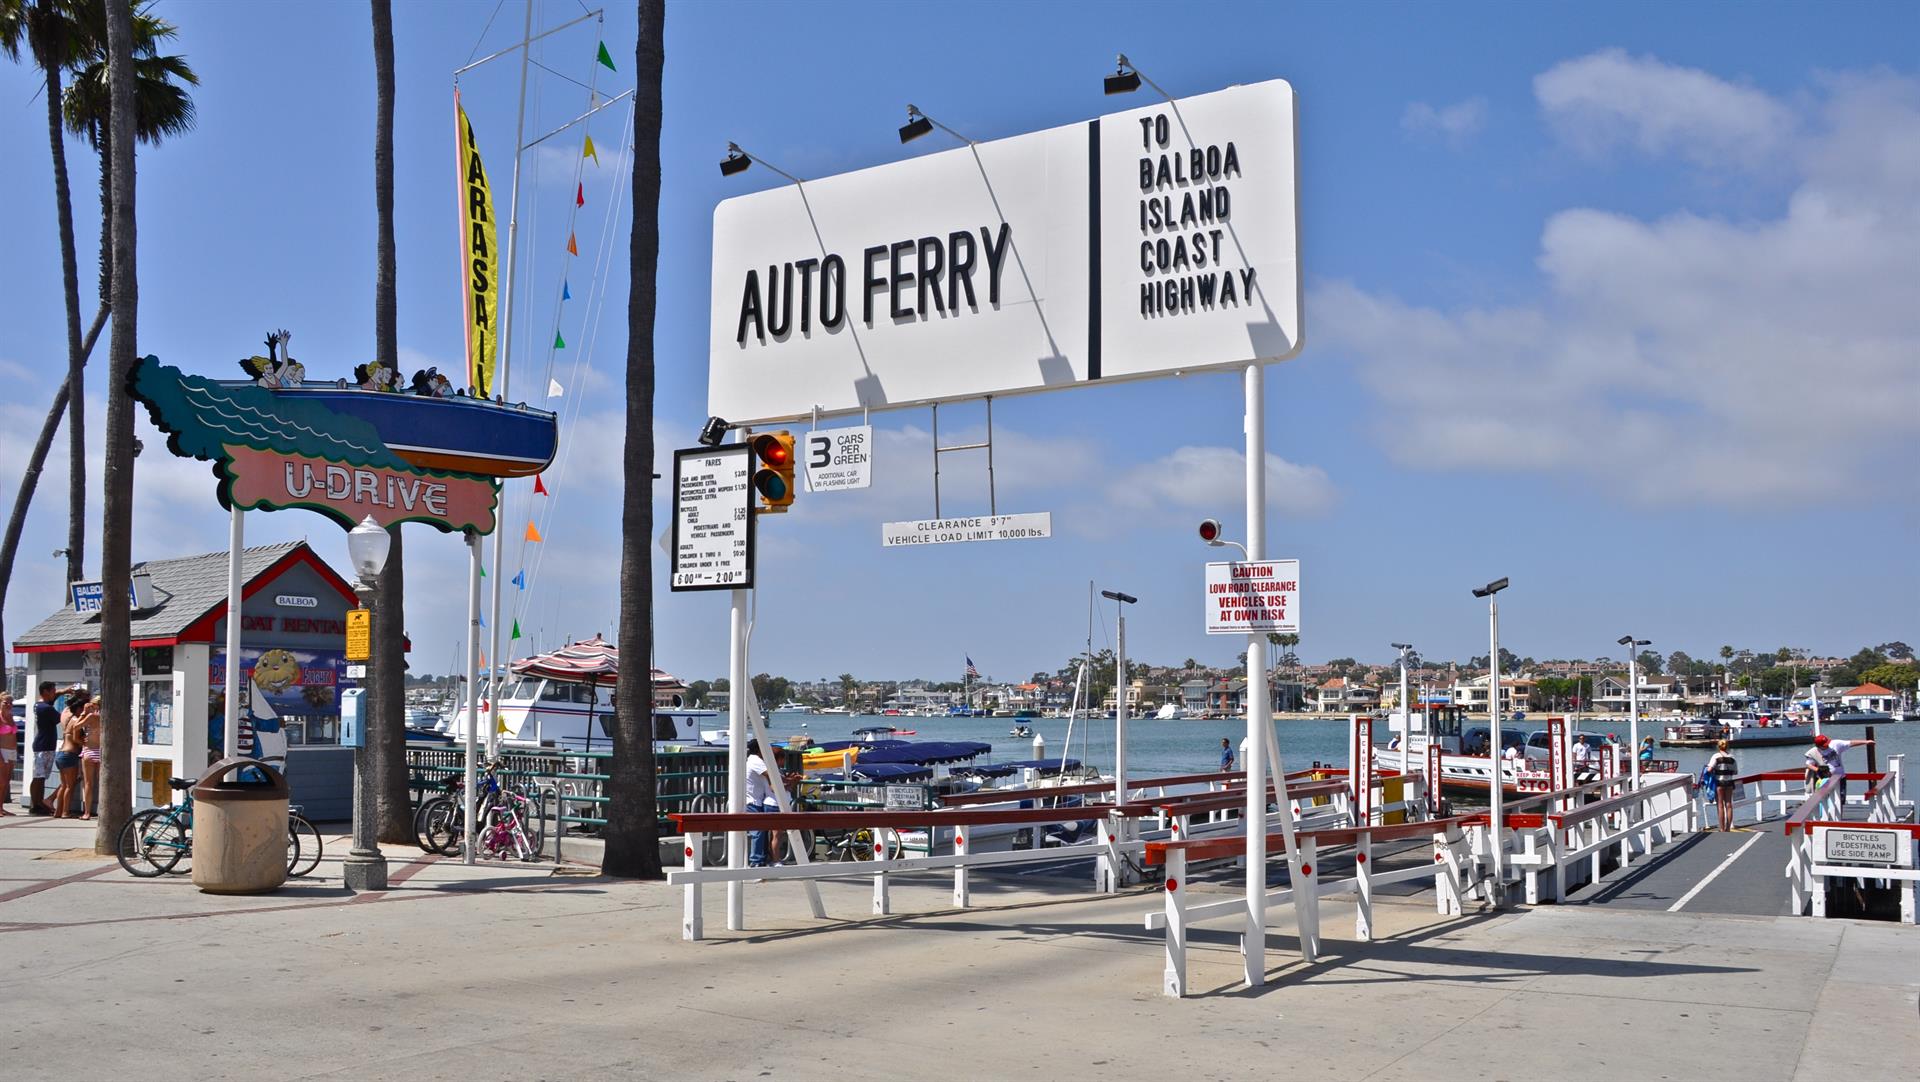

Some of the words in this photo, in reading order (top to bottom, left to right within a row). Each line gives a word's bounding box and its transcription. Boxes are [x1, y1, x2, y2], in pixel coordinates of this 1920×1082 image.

[1139, 113, 1169, 148] TO
[1139, 141, 1240, 190] BALBOA
[1140, 185, 1230, 231] ISLAND
[1140, 229, 1223, 272] COAST
[736, 252, 846, 343] AUTO
[862, 222, 1010, 323] FERRY
[1140, 267, 1255, 316] HIGHWAY
[837, 433, 864, 446] CARS
[810, 436, 831, 469] 3
[841, 444, 860, 455] PER
[705, 458, 722, 467] FARES
[833, 453, 867, 466] GREEN
[818, 471, 845, 480] ADDITIONAL
[846, 470, 857, 478] CAR
[284, 461, 448, 516] U-DRIVE
[822, 479, 846, 487] FLASHING
[847, 477, 860, 485] LIGHT
[917, 518, 982, 532] CLEARANCE
[888, 531, 930, 545] VEHICLE
[934, 532, 962, 542] LOAD
[967, 530, 994, 540] LIMIT
[998, 528, 1026, 539] 10,000
[1028, 527, 1045, 537] lbs.
[1232, 566, 1273, 578] CAUTION
[76, 584, 103, 597] BALBO
[1209, 583, 1227, 594] LOW
[1228, 582, 1250, 593] ROAD
[1251, 581, 1297, 593] CLEARANCE
[279, 596, 315, 606] BALBOA
[1218, 595, 1265, 608] VEHICLES
[1267, 595, 1287, 607] USE
[1220, 610, 1232, 621] AT
[1234, 609, 1258, 622] OWN
[1260, 609, 1285, 621] RISK
[241, 614, 276, 632] OAT
[283, 617, 347, 636] RENTA
[1553, 741, 1561, 790] CAUTIO
[1519, 779, 1549, 792] STO
[1842, 833, 1880, 842] BICYCLES
[1835, 841, 1887, 851] PEDESTRIANS
[1848, 850, 1865, 858] SIDE
[1868, 851, 1892, 859] RAMP
